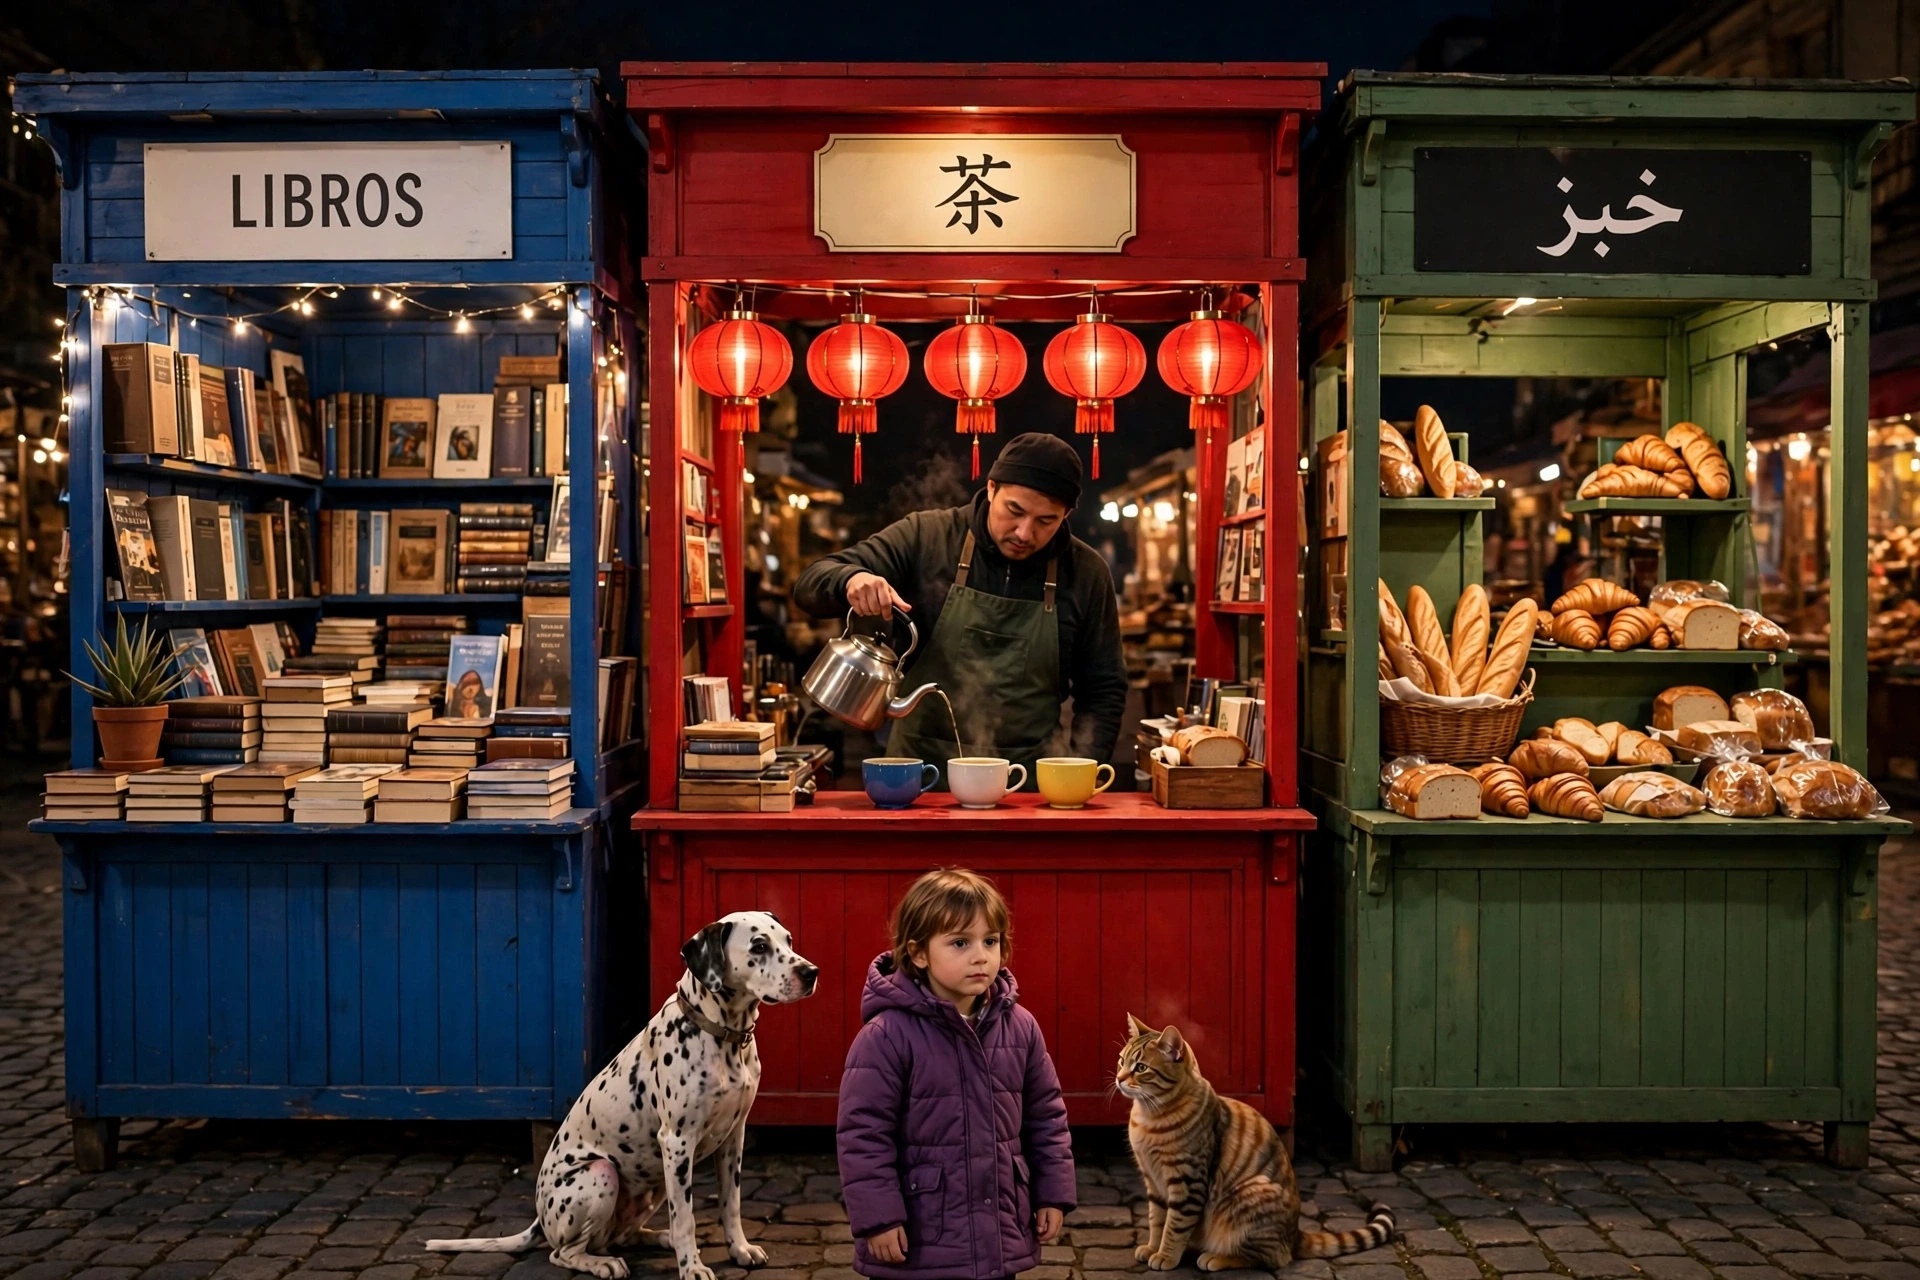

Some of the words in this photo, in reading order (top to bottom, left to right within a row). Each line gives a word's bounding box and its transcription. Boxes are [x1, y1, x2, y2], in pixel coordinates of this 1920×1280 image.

[232, 172, 424, 228] LIBROS
[934, 153, 1020, 235] 茶
[1536, 168, 1684, 258] خبز
